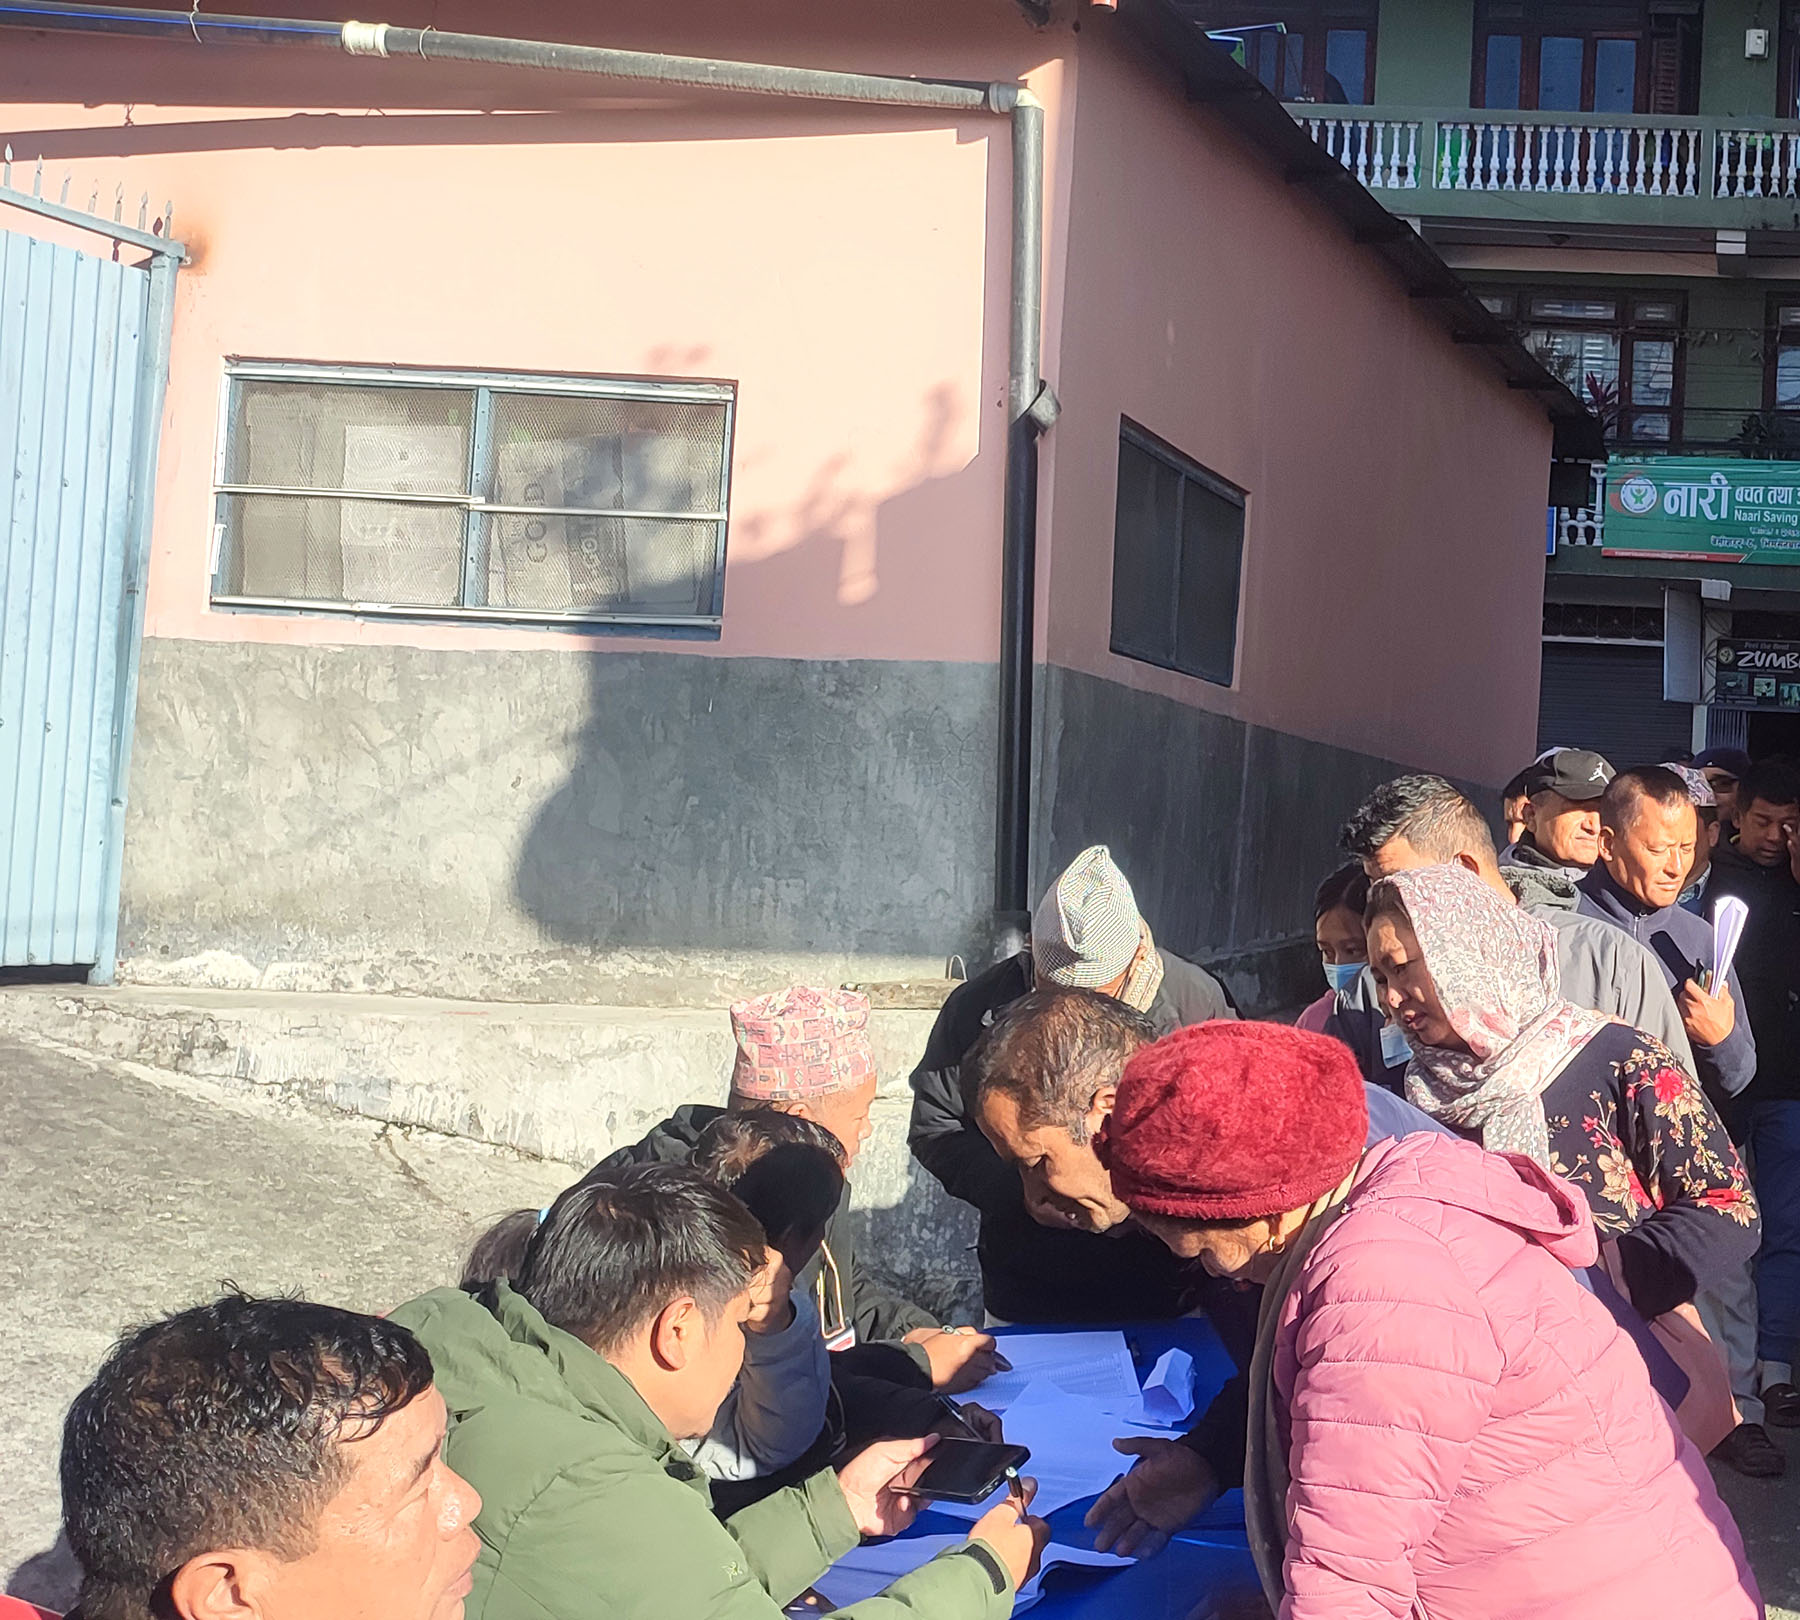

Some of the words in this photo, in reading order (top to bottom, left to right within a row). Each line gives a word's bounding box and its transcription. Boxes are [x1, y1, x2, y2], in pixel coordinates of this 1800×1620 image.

[1663, 472, 1732, 521] नारी
[1735, 486, 1764, 504] बचत
[1767, 486, 1794, 505] तथा
[1734, 509, 1761, 522] Naari
[1763, 511, 1798, 527] Saving
